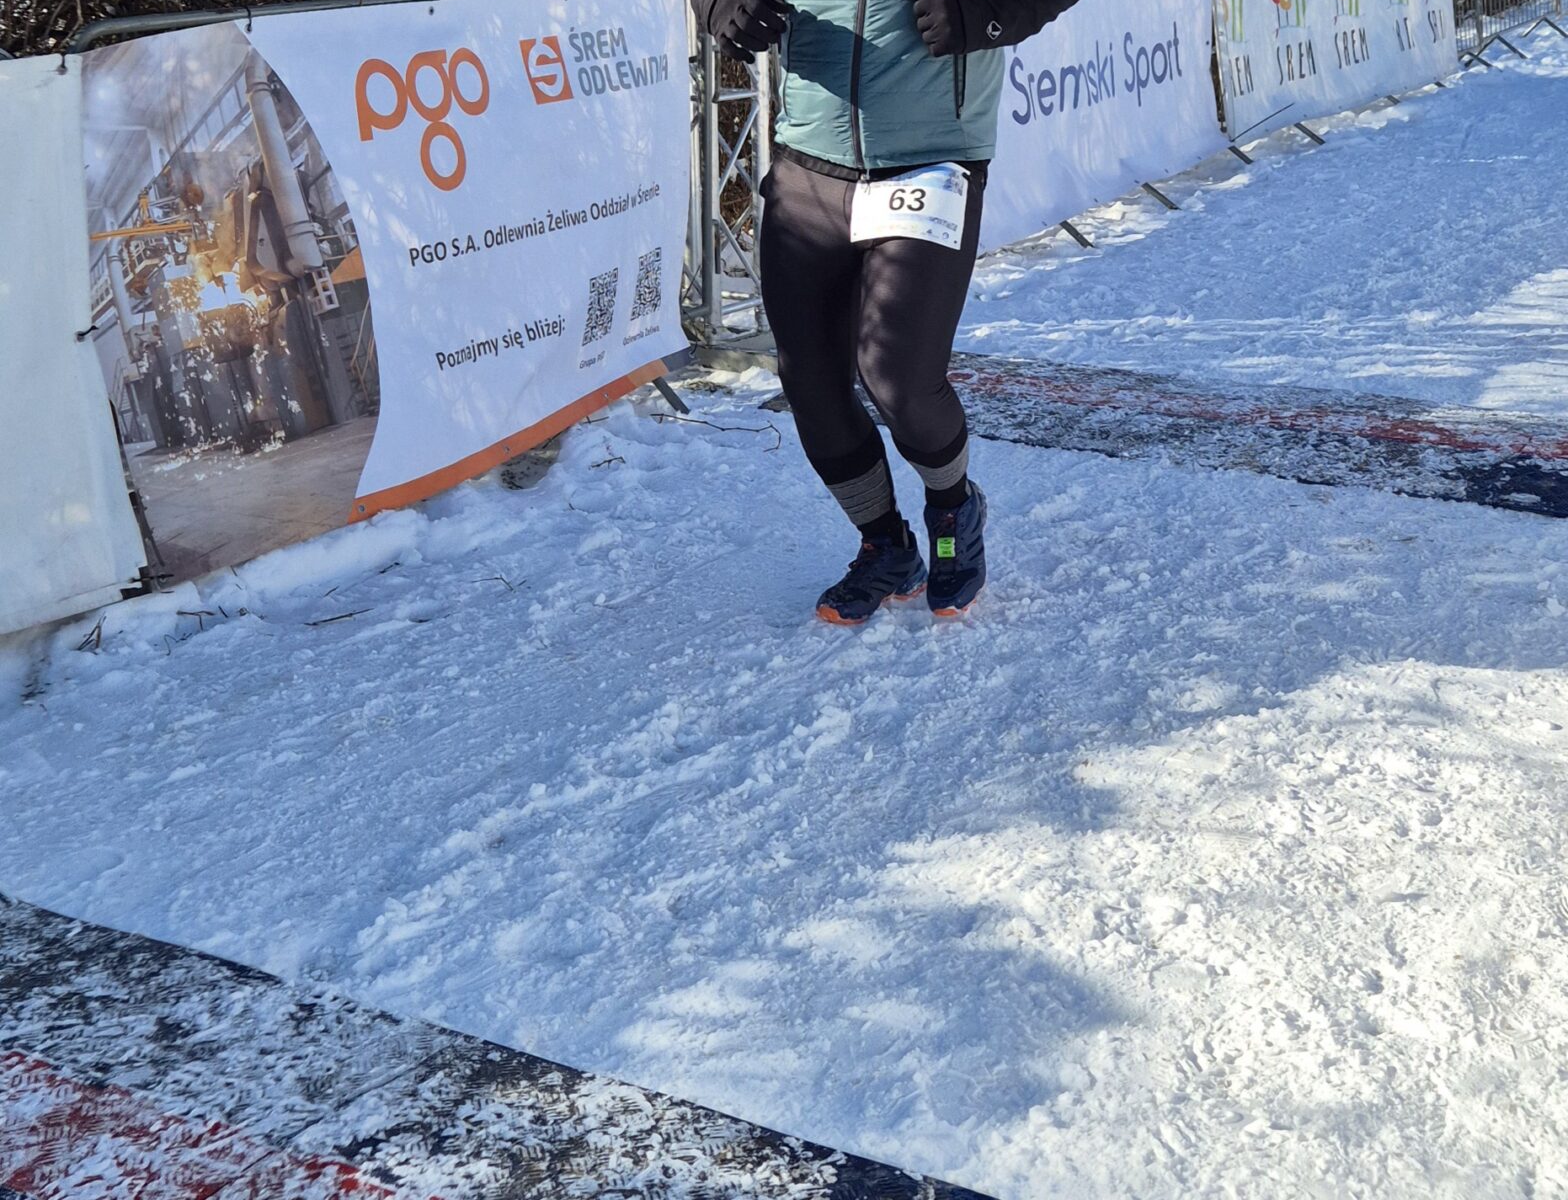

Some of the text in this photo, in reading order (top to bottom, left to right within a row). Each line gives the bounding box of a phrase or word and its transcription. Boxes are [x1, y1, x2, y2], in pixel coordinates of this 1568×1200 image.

[568, 27, 628, 63] ŚREM
[577, 53, 668, 97] ODLEWNIA
[1009, 21, 1183, 126] Śremski Sport
[888, 188, 926, 212] 63
[409, 242, 447, 267] PGO
[451, 234, 481, 257] S.A.
[484, 217, 545, 249] Odlewnia
[546, 209, 588, 232] Żeliwa
[590, 193, 629, 221] Oddział
[435, 314, 566, 371] Poznajmy się bliżej:
